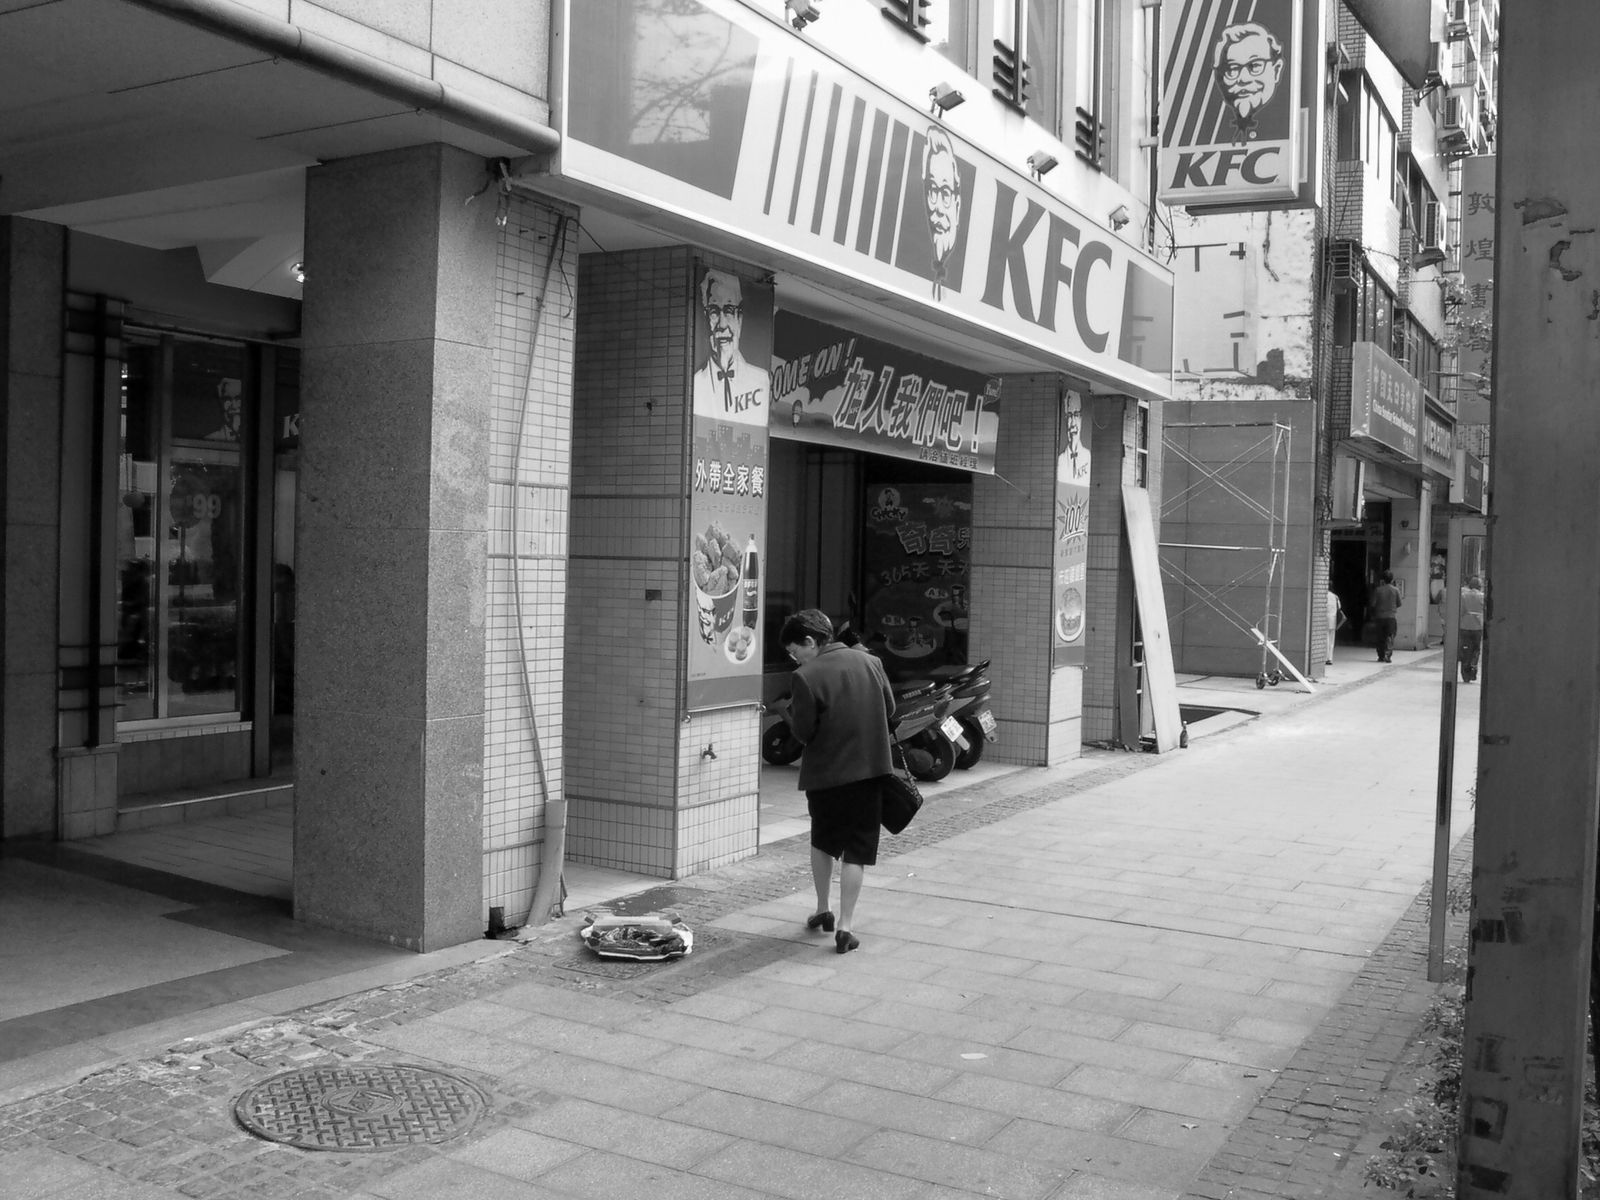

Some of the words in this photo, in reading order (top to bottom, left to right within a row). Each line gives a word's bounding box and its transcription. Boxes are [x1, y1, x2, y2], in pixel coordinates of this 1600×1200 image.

[1169, 146, 1280, 189] KFC
[982, 178, 1113, 354] KFC
[733, 388, 762, 412] KFC
[695, 457, 764, 498] 外帶全家餐
[1065, 505, 1081, 534] 100
